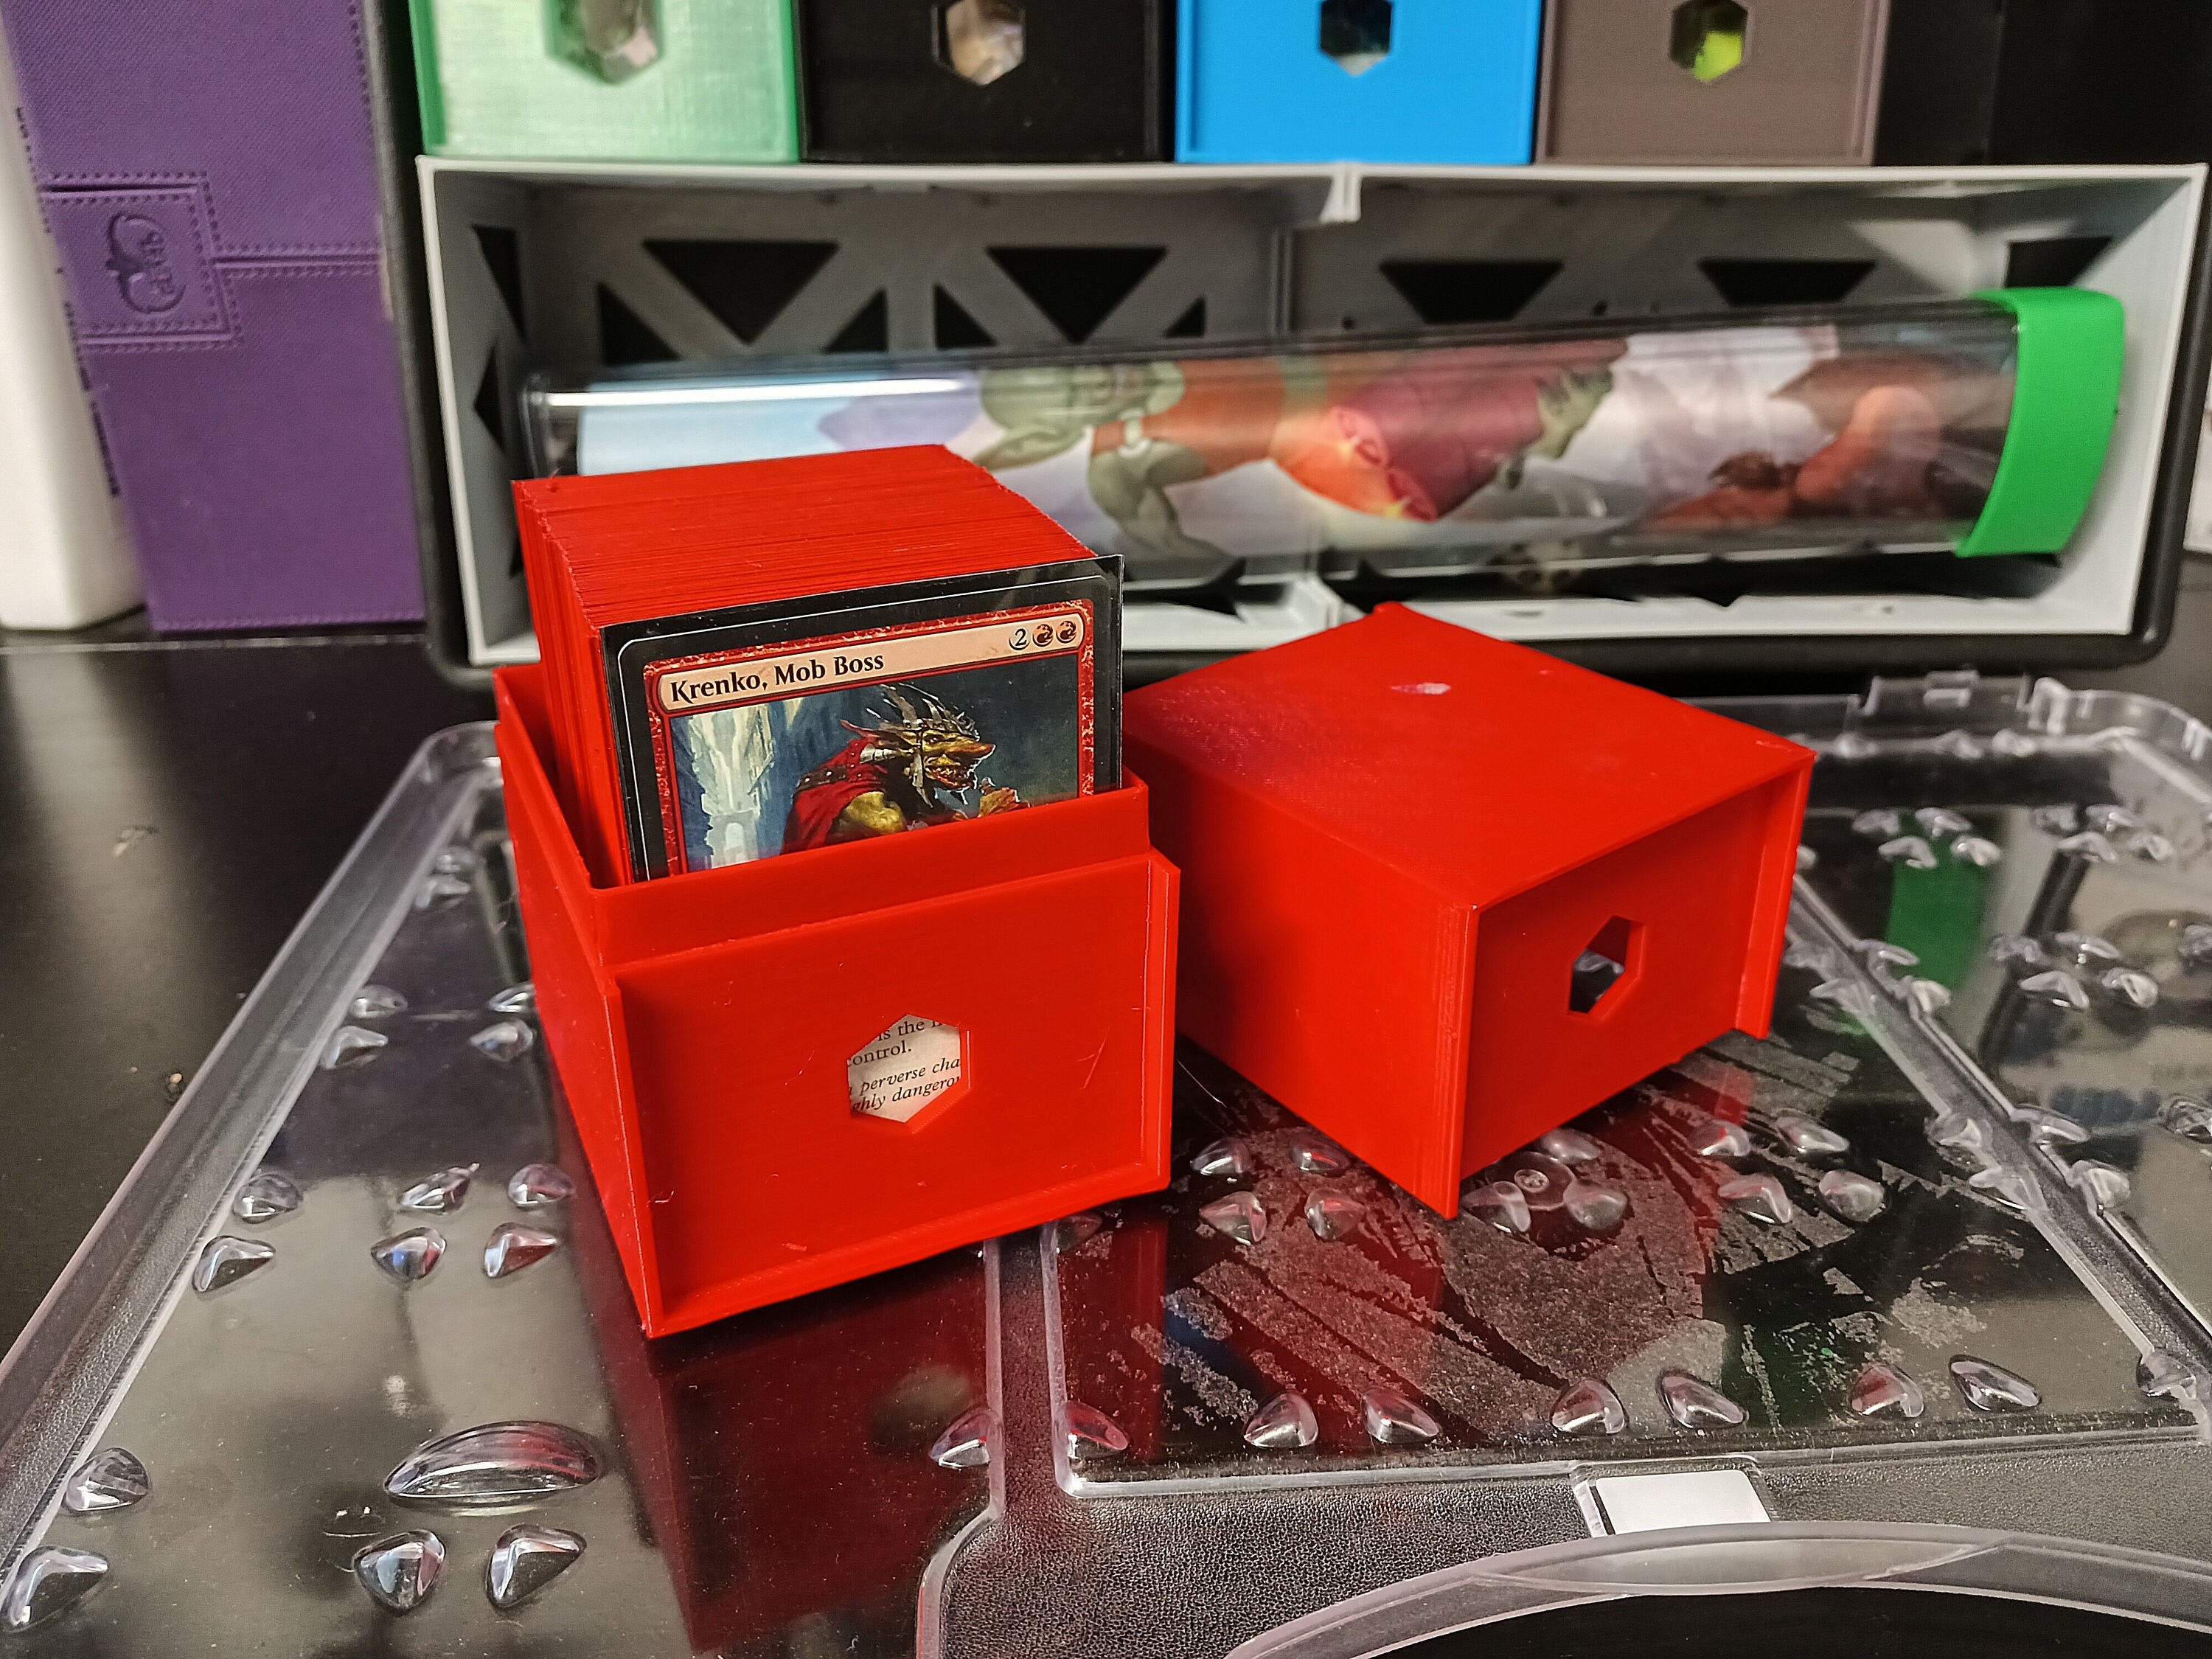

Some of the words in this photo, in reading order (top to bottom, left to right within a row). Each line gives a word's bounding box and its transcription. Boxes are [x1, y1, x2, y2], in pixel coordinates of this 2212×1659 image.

[1015, 628, 1027, 646] 2
[671, 672, 768, 704] Krenko,
[774, 659, 826, 686] Mob
[834, 655, 884, 676] Boss
[897, 1020, 925, 1036] the
[860, 1067, 925, 1096] perverse
[932, 1057, 960, 1073] cha
[892, 1076, 959, 1102] dangero
